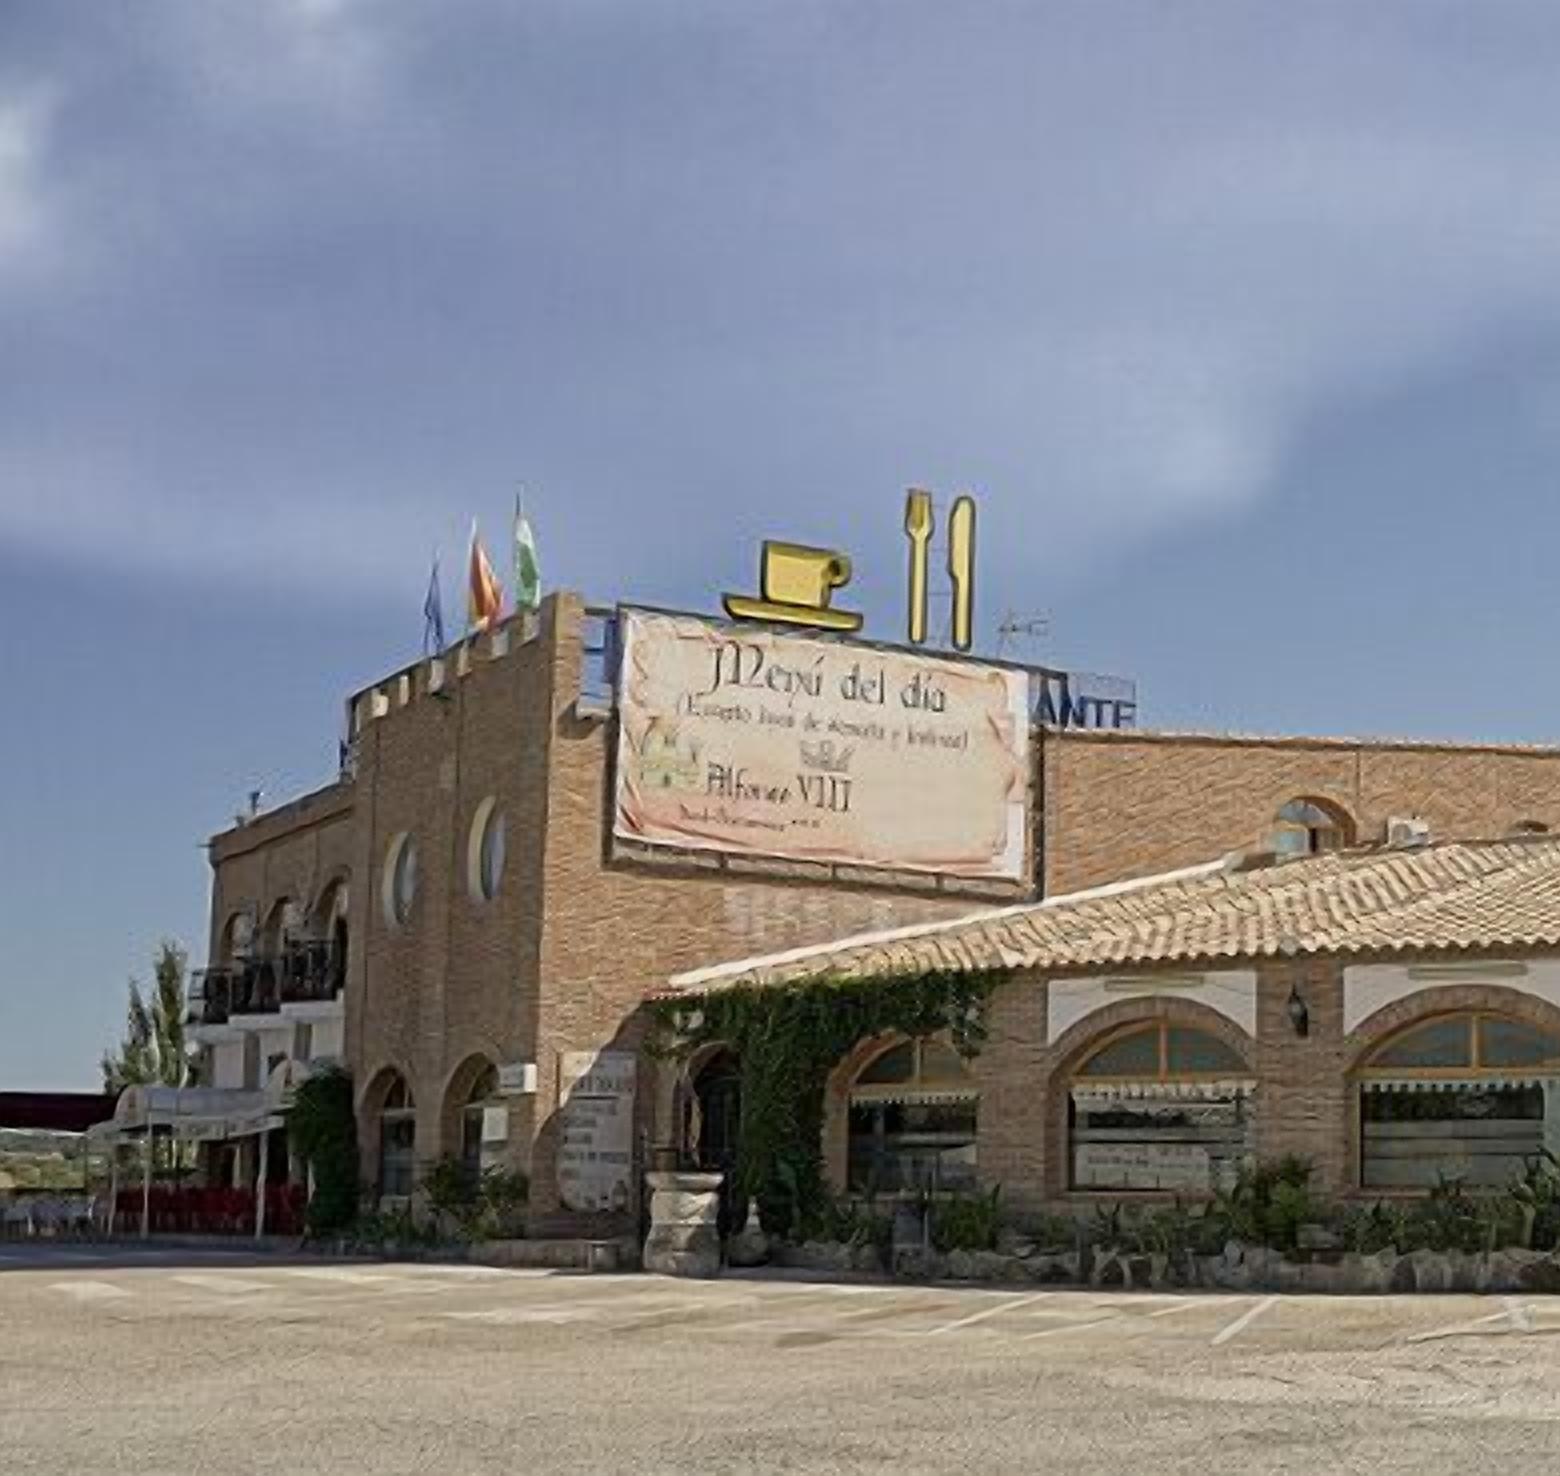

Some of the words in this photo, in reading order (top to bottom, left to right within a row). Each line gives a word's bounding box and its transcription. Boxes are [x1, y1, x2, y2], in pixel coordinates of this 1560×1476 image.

[697, 640, 824, 708] Menú
[840, 662, 885, 705] del
[900, 669, 946, 713] día
[797, 773, 852, 814] VIII
